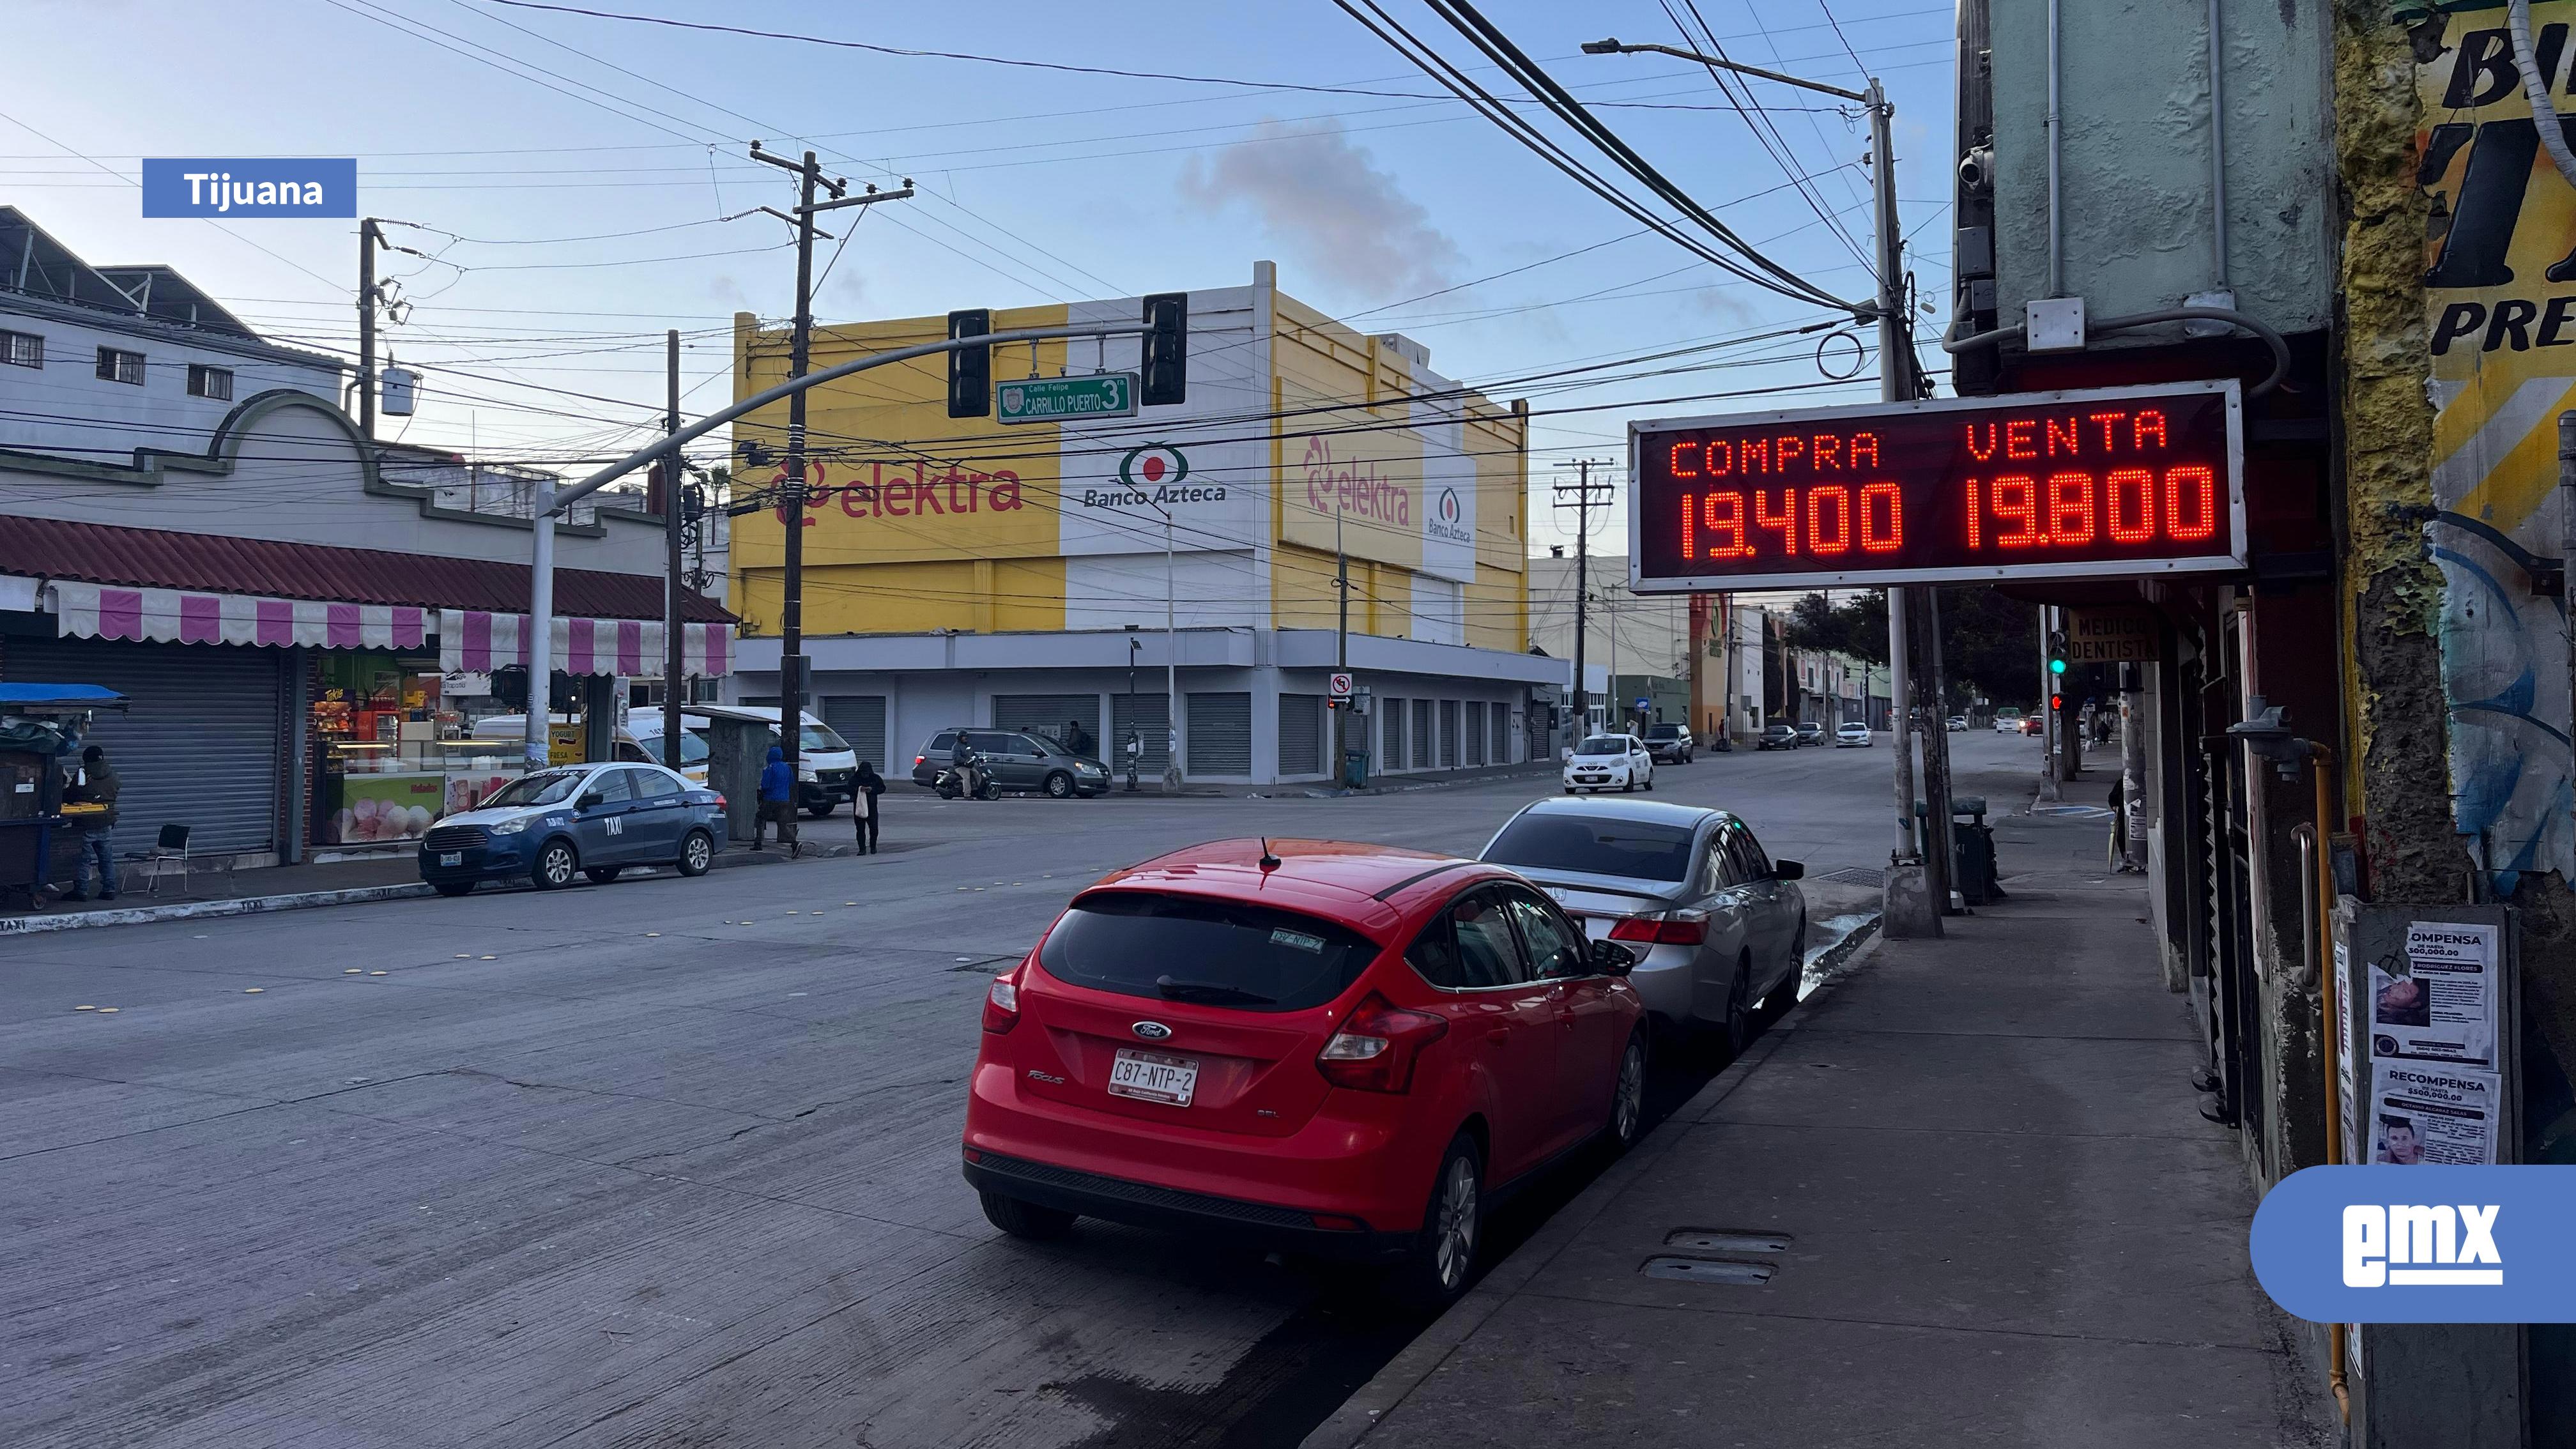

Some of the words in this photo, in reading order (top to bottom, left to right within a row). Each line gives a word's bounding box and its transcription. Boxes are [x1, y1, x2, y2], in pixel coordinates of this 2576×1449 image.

[1048, 383, 1069, 392] Felipe
[1025, 395, 1065, 415] CARRILLO
[1067, 394, 1101, 412] PUERTO
[1967, 410, 2166, 461] VENTA
[1671, 433, 1880, 478] COMPRA
[841, 458, 1023, 518] elektra
[1084, 489, 1147, 507] Banco
[1153, 486, 1226, 503] Azteca
[1338, 456, 1409, 526] elektra
[1966, 466, 2214, 548] 19.800
[1429, 518, 1448, 538] Banco
[1449, 524, 1471, 543] Azteca
[1682, 482, 1902, 559] 19.400
[2079, 617, 2147, 637] MEDICO
[2071, 640, 2156, 661] DENTISTA
[604, 816, 622, 836] TAXI
[2411, 933, 2481, 946] OMPENSA
[1140, 1023, 1162, 1036] Ford
[1115, 1061, 1192, 1092] C87-NTP-2
[2389, 1070, 2486, 1092] RECOMPENSA
[2407, 1087, 2462, 1101] $500,000.00
